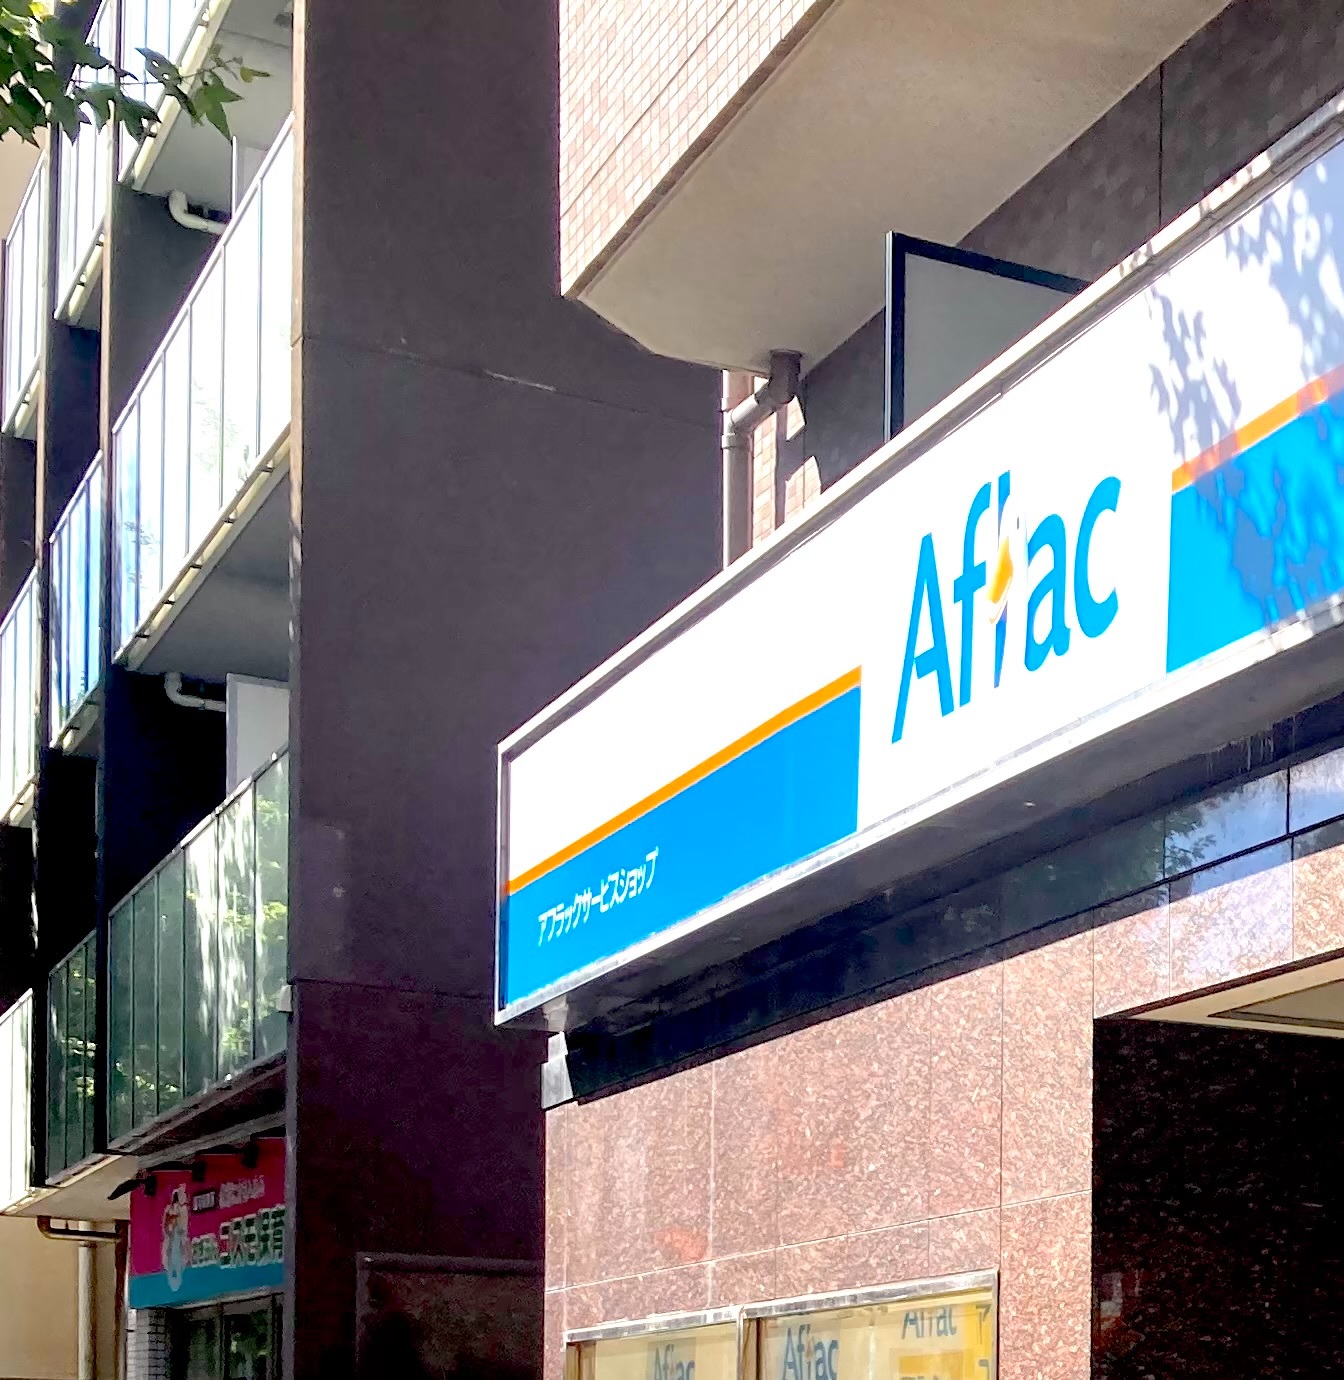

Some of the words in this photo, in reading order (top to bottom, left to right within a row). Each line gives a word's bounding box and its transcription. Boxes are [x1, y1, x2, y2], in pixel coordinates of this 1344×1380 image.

[891, 470, 1121, 744] Aflac
[538, 845, 659, 948] アフラックサービスショップ
